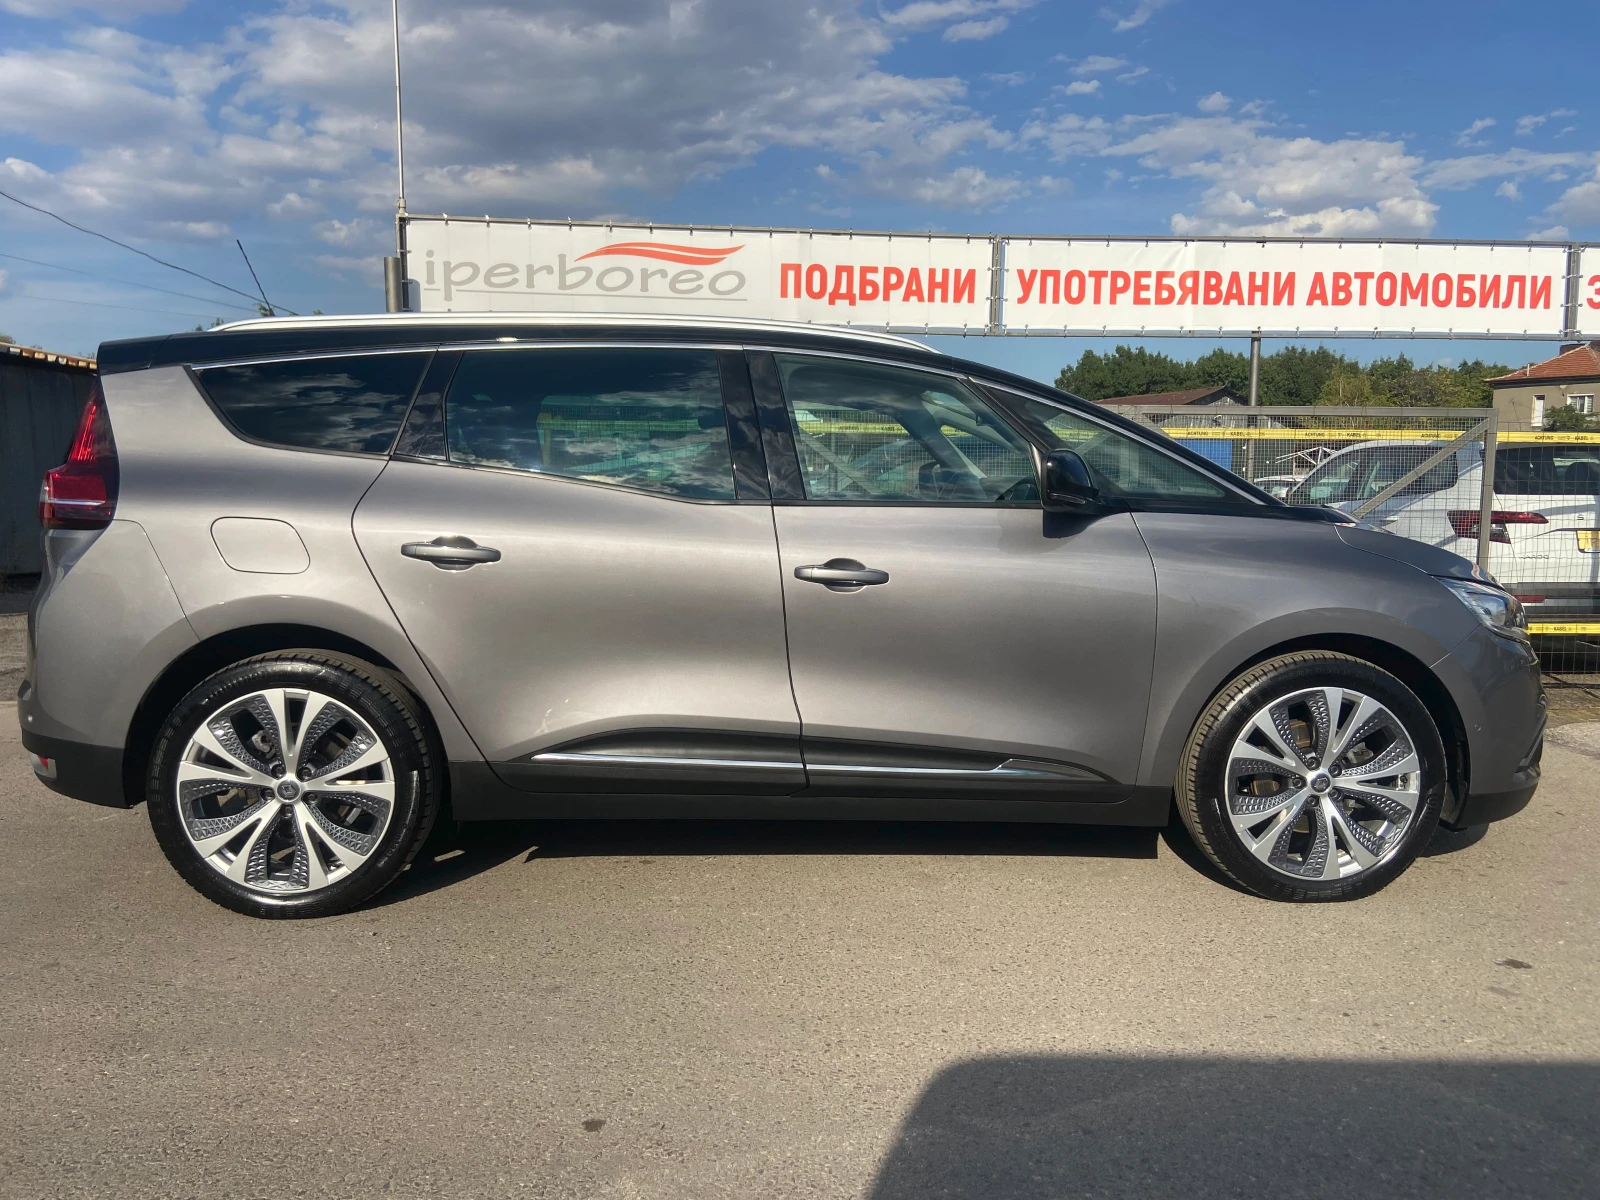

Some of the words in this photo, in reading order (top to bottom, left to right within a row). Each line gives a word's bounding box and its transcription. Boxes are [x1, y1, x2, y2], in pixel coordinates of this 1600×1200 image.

[425, 249, 746, 301] iperboreo
[780, 263, 977, 307] ПОДБРАНИ
[1016, 269, 1296, 307] УПОТРЕБЯВАНИ
[1305, 271, 1552, 310] АВТОМОБИЛИ
